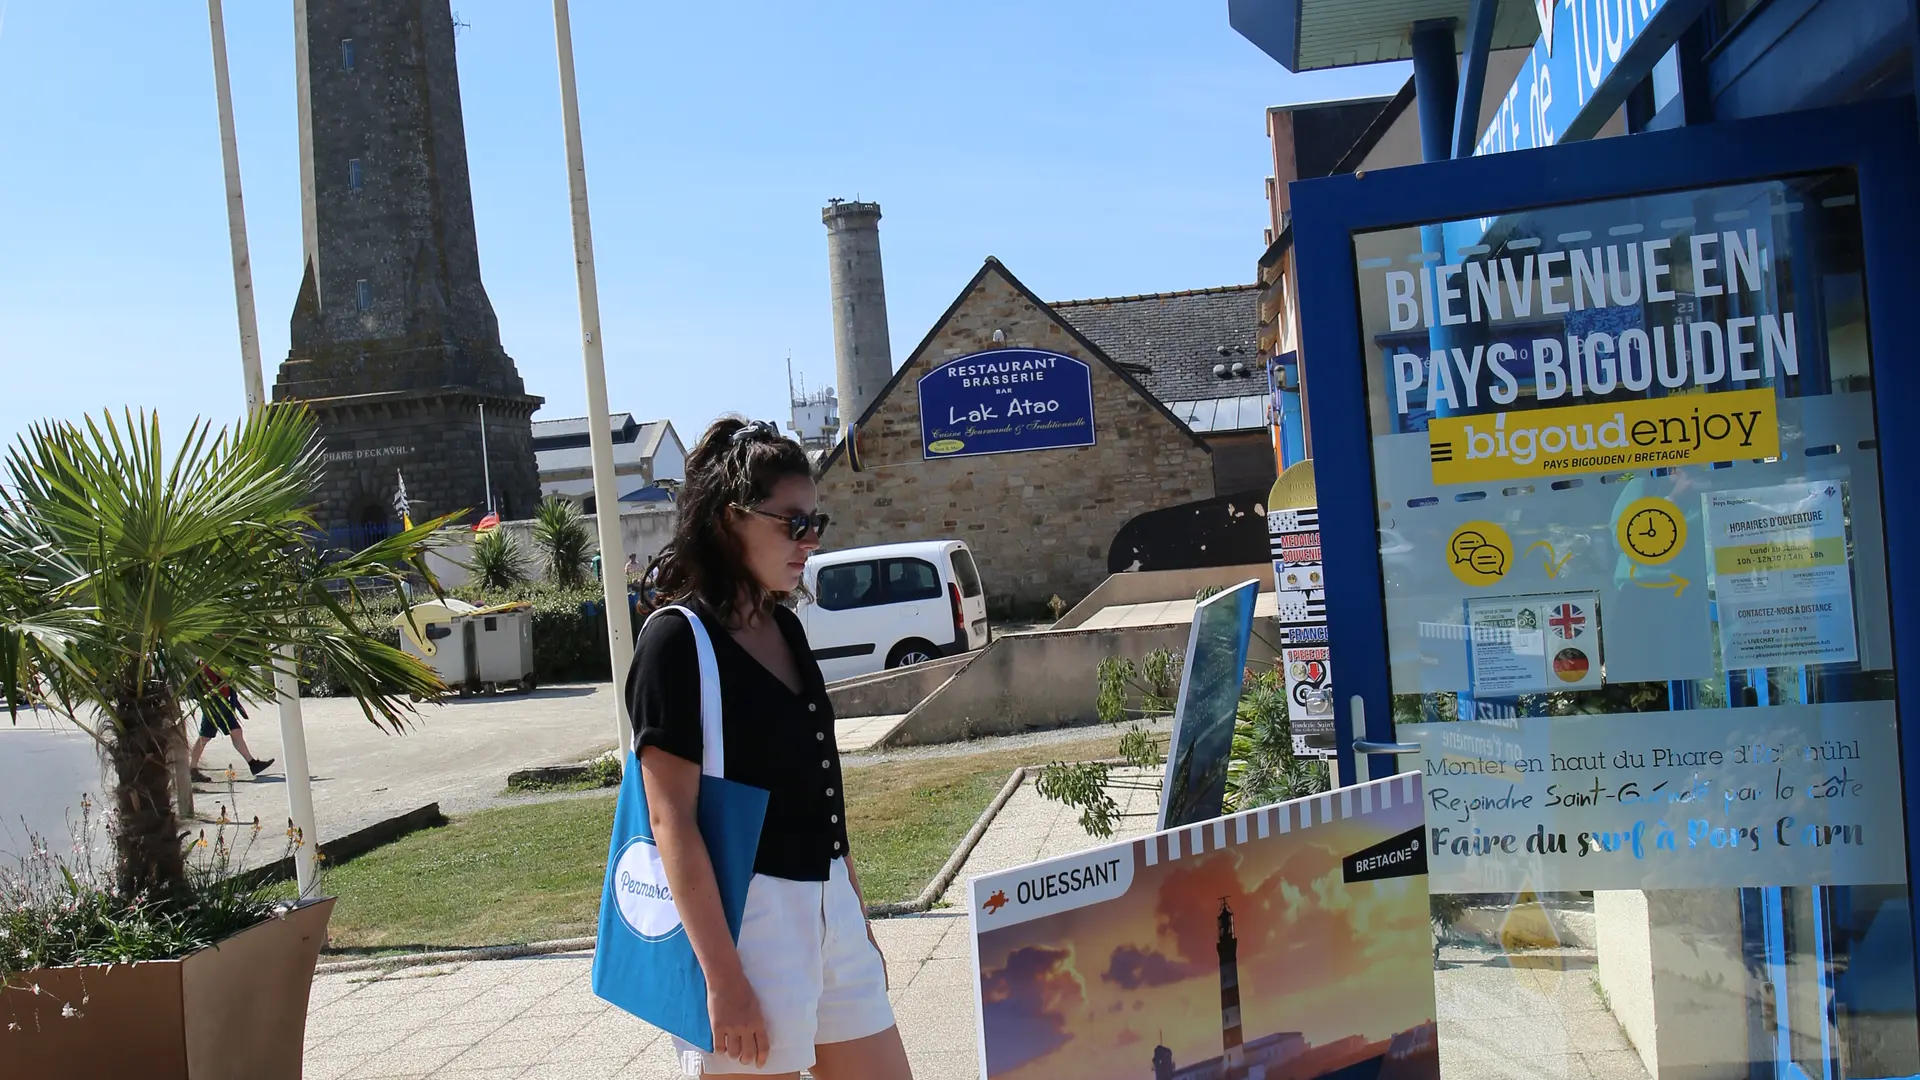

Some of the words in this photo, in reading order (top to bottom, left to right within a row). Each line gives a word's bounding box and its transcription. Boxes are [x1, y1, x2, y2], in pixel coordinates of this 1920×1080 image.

[1386, 238, 1676, 331] BIENVENUE
[1690, 228, 1763, 298] EN
[948, 358, 1057, 377] RESTAURANT
[1394, 342, 1518, 414] PAYS
[1532, 312, 1799, 402] BIGOUDEN
[963, 371, 1044, 388] BRASSERIE
[949, 403, 998, 425] Lak
[1007, 398, 1059, 417] Atao
[931, 428, 961, 439] Cuisine
[965, 425, 1013, 437] Gourmande
[1026, 418, 1085, 430] Traditionnelle
[323, 451, 353, 461] PHARE
[1543, 458, 1569, 471] PAYS
[1572, 454, 1625, 468] BIGOUDEN
[1627, 453, 1632, 465] /
[1634, 449, 1690, 463] BRETAGNE
[1729, 518, 1769, 533] HORAIRES
[1770, 510, 1823, 527] D'OUVERTURE
[1749, 546, 1770, 555] Lundi
[1810, 551, 1824, 559] 18h
[1738, 606, 1794, 619] CONTACTEZ-NOUS
[1801, 603, 1832, 613] DISTANCE
[1425, 757, 1507, 776] Monter
[1514, 757, 1544, 773] en
[1551, 751, 1605, 772] haut
[1613, 750, 1645, 769] du
[1653, 749, 1723, 767] Phare
[1428, 784, 1533, 823] Rejoindre
[1724, 787, 1763, 816] par
[1775, 768, 1794, 800] la
[1807, 766, 1863, 798] côte
[1431, 827, 1518, 856] Faire
[1526, 824, 1567, 855] du
[1577, 820, 1645, 860] surf
[1656, 819, 1677, 852] à
[1688, 818, 1762, 851] Pors
[1773, 816, 1863, 847] Carn
[1356, 847, 1412, 873] BRETAGNE
[621, 870, 674, 901] Penmarc
[1017, 859, 1121, 905] OUESSANT
